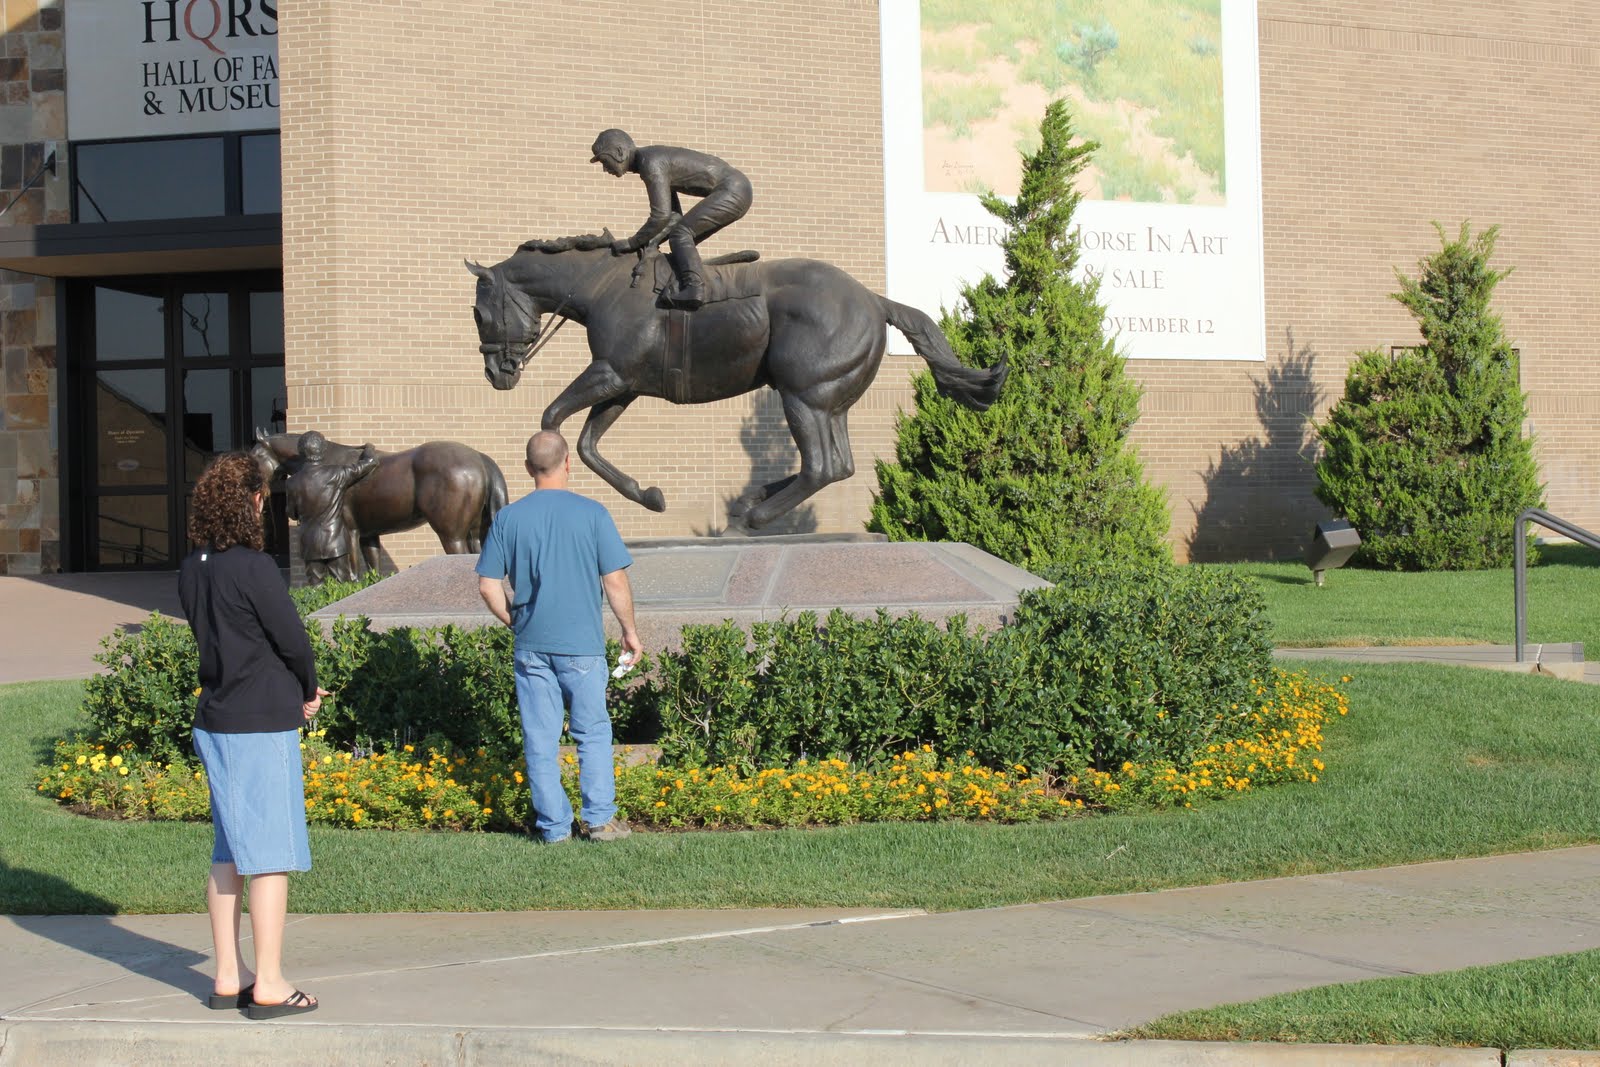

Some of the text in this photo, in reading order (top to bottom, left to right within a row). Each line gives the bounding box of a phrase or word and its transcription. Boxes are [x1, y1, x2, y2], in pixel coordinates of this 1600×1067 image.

[142, 54, 279, 87] HALL OF FA
[143, 83, 281, 116] & MUSEU
[929, 217, 1008, 246] AMERI
[1145, 226, 1171, 252] IN
[1180, 228, 1228, 255] ART
[1112, 269, 1165, 289] SALE
[1100, 317, 1215, 334] OVEMBER 12
